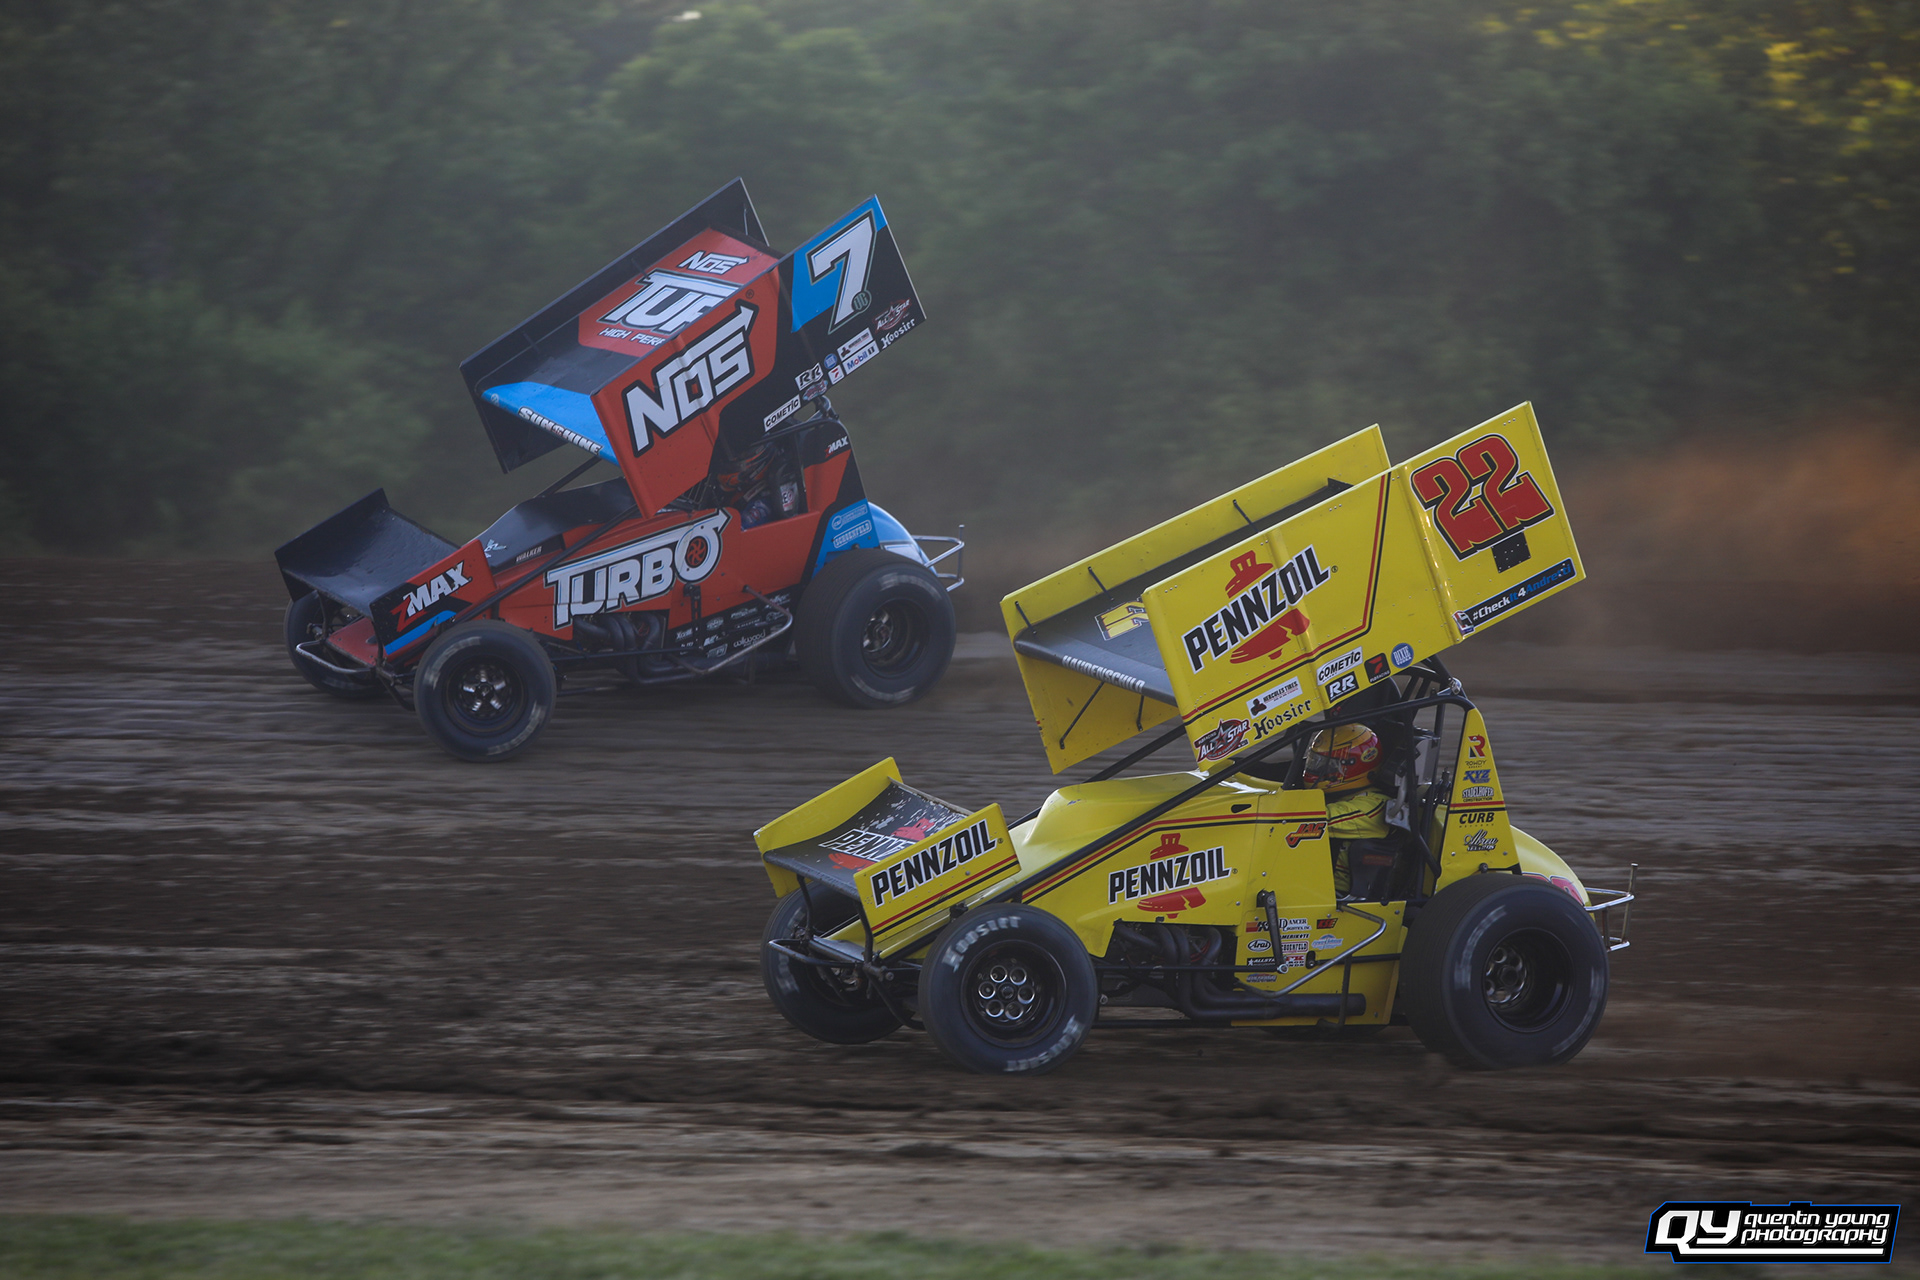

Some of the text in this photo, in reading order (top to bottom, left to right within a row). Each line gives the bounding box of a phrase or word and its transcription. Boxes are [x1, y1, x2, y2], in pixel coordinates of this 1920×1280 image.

[676, 250, 749, 275] NOS
[806, 211, 876, 334] 7
[598, 327, 633, 339] HIGH
[881, 318, 915, 349] Hoosier
[624, 303, 755, 454] NOS
[847, 351, 868, 369] Mobil
[518, 406, 603, 455] SUNSHINE
[1410, 433, 1554, 561] 22
[545, 508, 729, 627] TURBO
[1182, 545, 1331, 673] PENNZOIL
[1318, 651, 1361, 681] COMETIC
[1329, 674, 1355, 697] RR
[1253, 699, 1312, 740] Hoosier
[1200, 742, 1215, 758] ALL
[1227, 721, 1248, 742] STAR
[1463, 769, 1491, 783] XYZ
[1459, 812, 1495, 824] CURB
[871, 819, 996, 906] PENNZOIL
[1109, 847, 1230, 904] PENNZOIL
